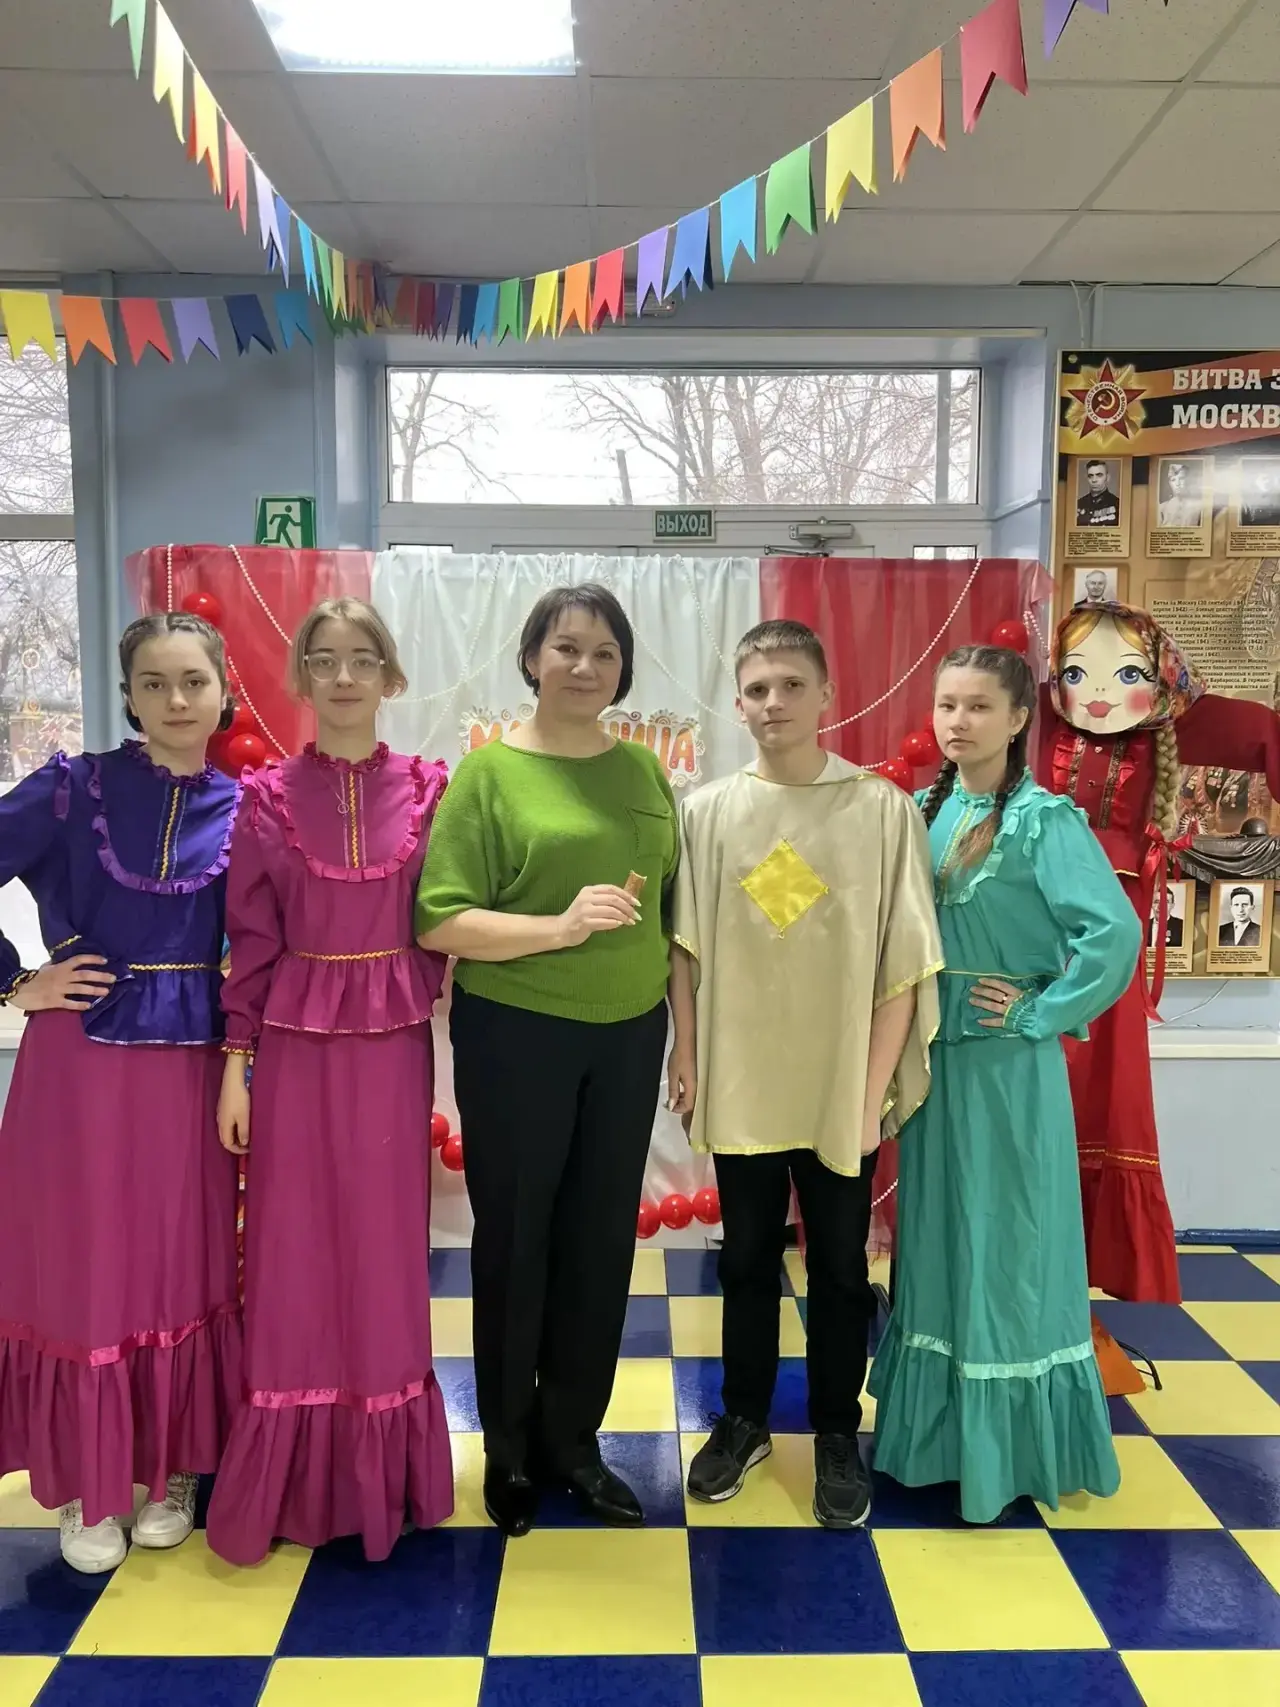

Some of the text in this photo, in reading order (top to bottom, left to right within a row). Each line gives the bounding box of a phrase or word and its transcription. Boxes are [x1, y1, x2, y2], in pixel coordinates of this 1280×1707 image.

[1172, 369, 1263, 390] БИТВА
[1086, 383, 1123, 421] ОТЕЧЕСТВЕННАЯ
[656, 514, 709, 536] ВЫХОД
